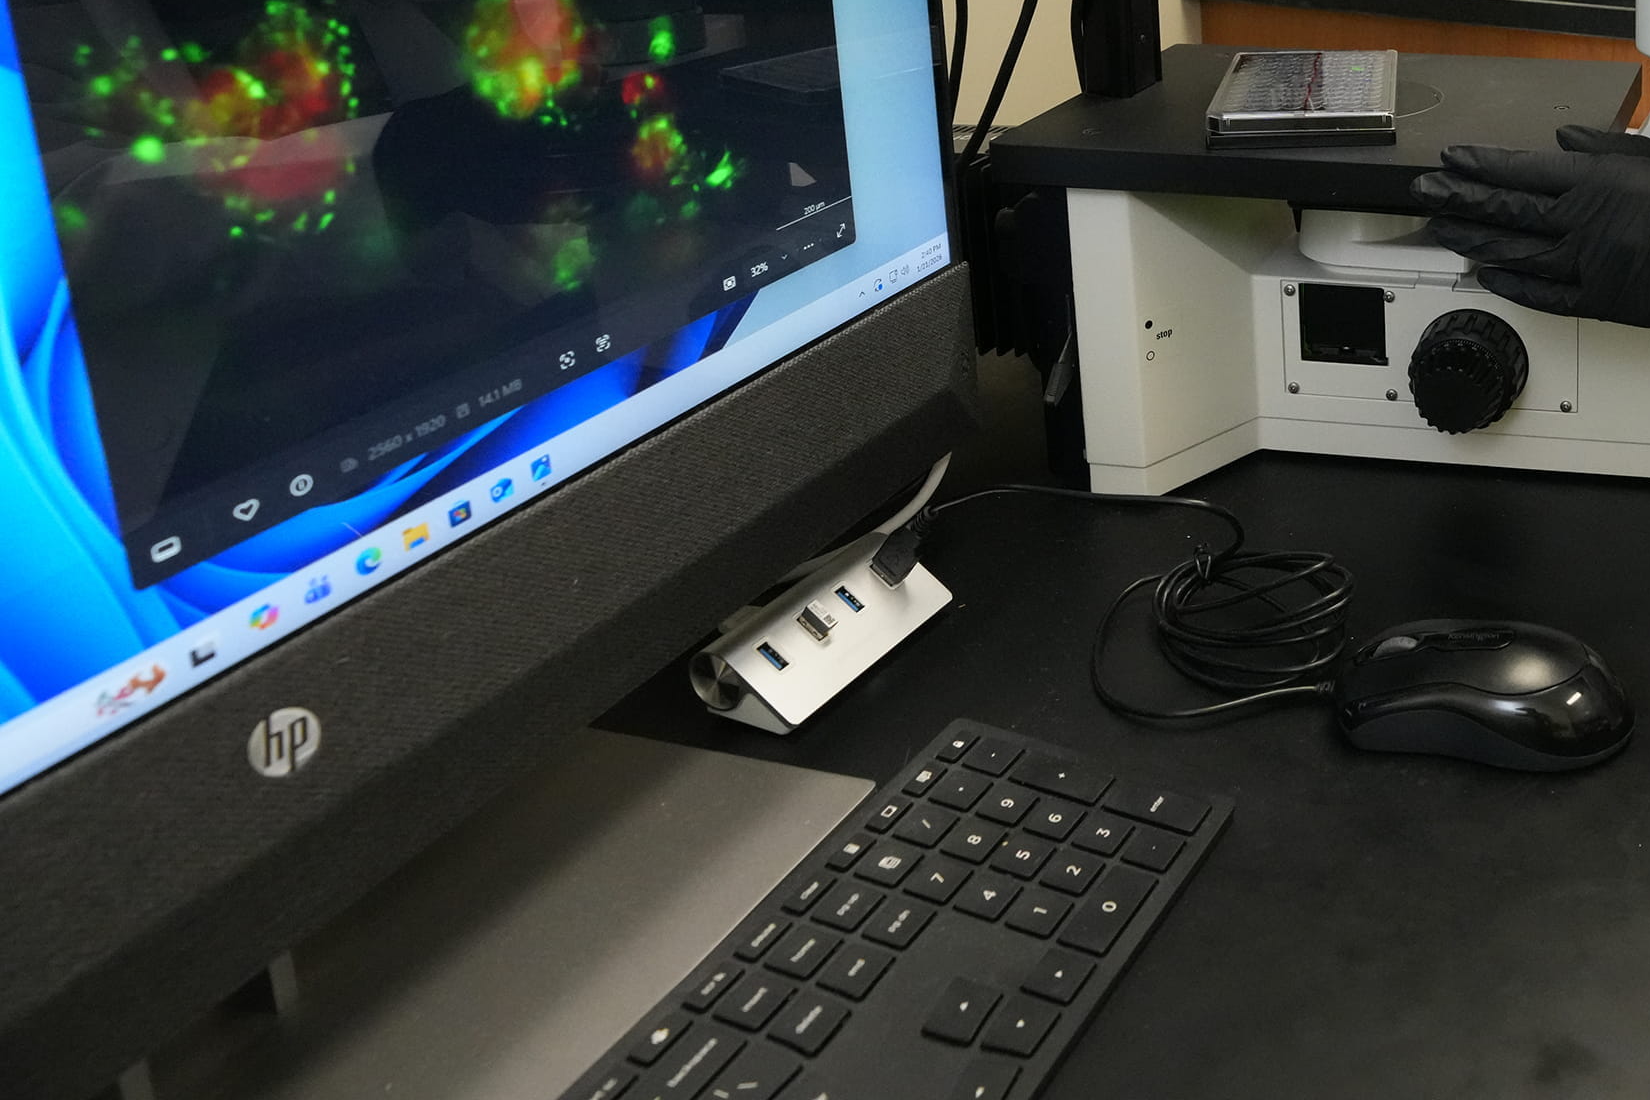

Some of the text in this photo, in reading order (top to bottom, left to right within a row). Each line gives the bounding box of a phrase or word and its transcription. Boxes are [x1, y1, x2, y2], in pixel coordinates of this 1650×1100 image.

[803, 204, 815, 215] 200
[750, 262, 769, 278] 32%
[1156, 329, 1173, 340] stop
[367, 435, 403, 461] 2560
[406, 432, 413, 443] x
[415, 414, 446, 438] 1920
[502, 379, 522, 397] MB
[1000, 798, 1014, 808] 9
[1048, 813, 1062, 824] 6
[1096, 828, 1111, 838] 3
[967, 835, 982, 845] 8
[1016, 850, 1031, 860] 5
[1066, 865, 1081, 876] 2
[930, 873, 945, 883] 7
[983, 889, 997, 901] 4
[1033, 906, 1048, 915] 1
[1102, 901, 1117, 912] 0
